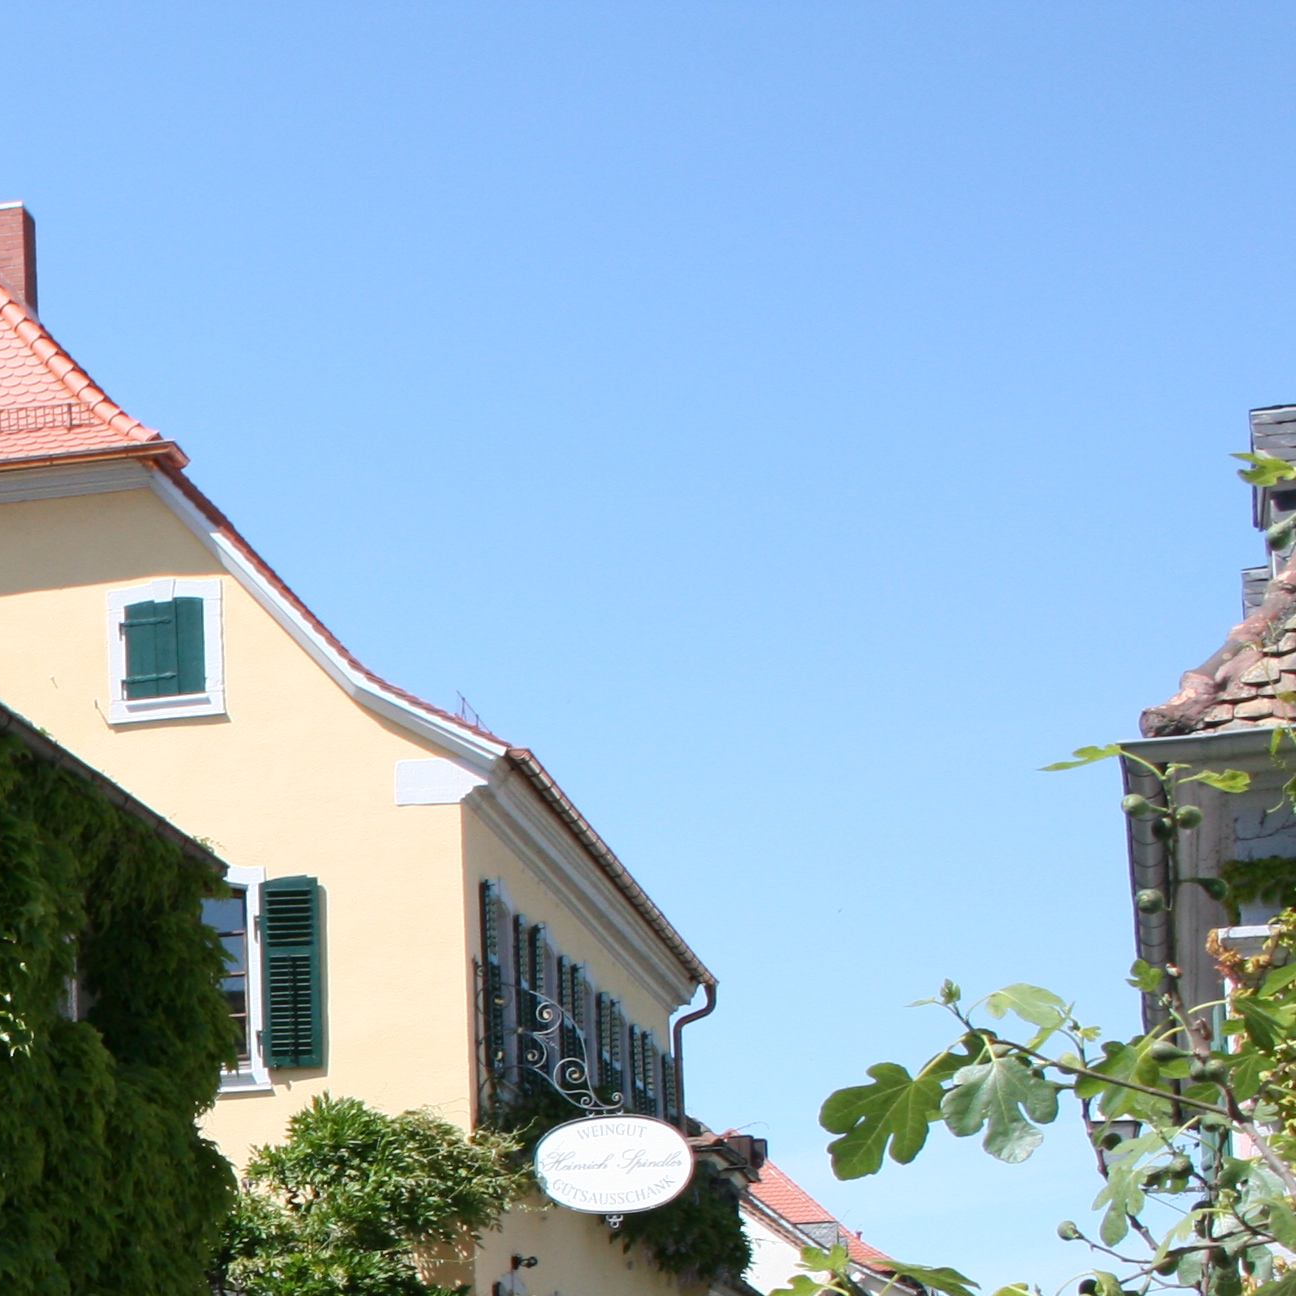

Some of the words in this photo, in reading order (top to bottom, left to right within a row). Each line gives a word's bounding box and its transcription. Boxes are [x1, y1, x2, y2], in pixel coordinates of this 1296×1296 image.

[577, 1123, 647, 1141] WEINGUT
[539, 1148, 615, 1172] Heinrich
[616, 1147, 683, 1175] Spindler
[552, 1174, 676, 1206] GUTSAUSSCHANK
